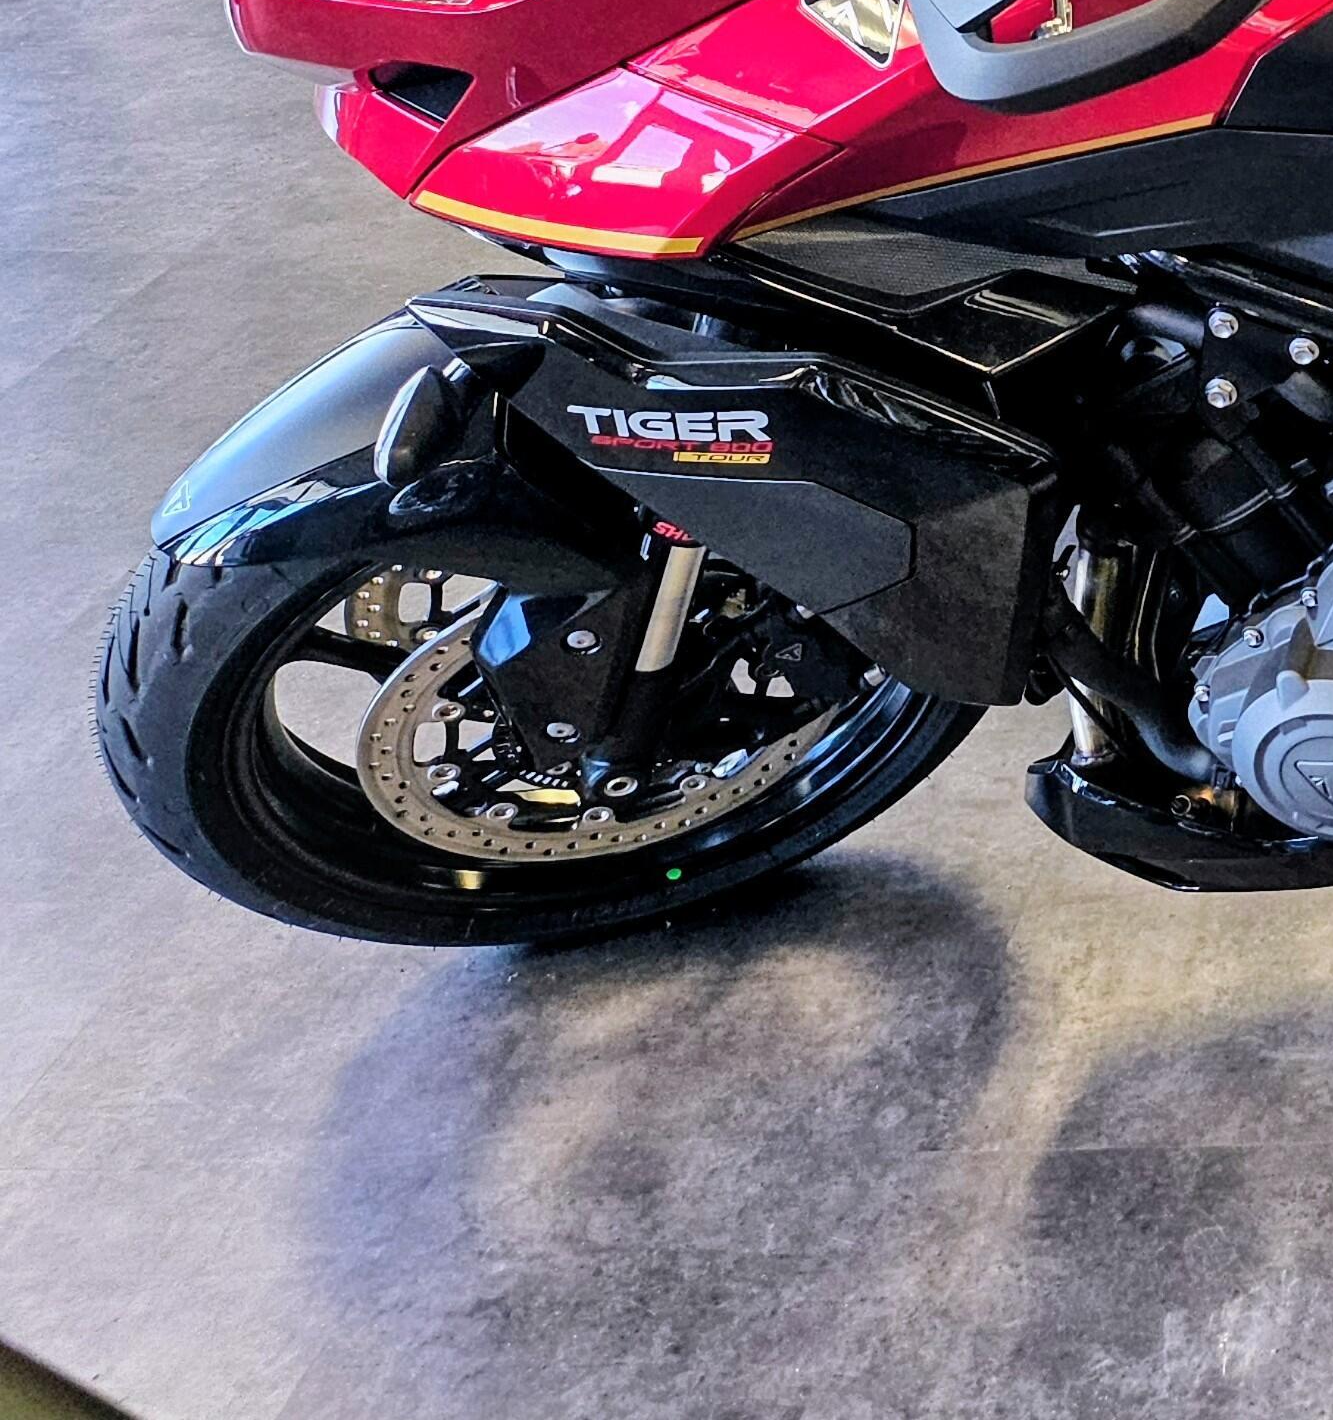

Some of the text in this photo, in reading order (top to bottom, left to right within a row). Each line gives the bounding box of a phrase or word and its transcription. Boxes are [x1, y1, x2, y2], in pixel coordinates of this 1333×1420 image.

[566, 404, 772, 442] TIGER
[591, 435, 773, 453] SPORT 800
[692, 453, 766, 462] TOUR
